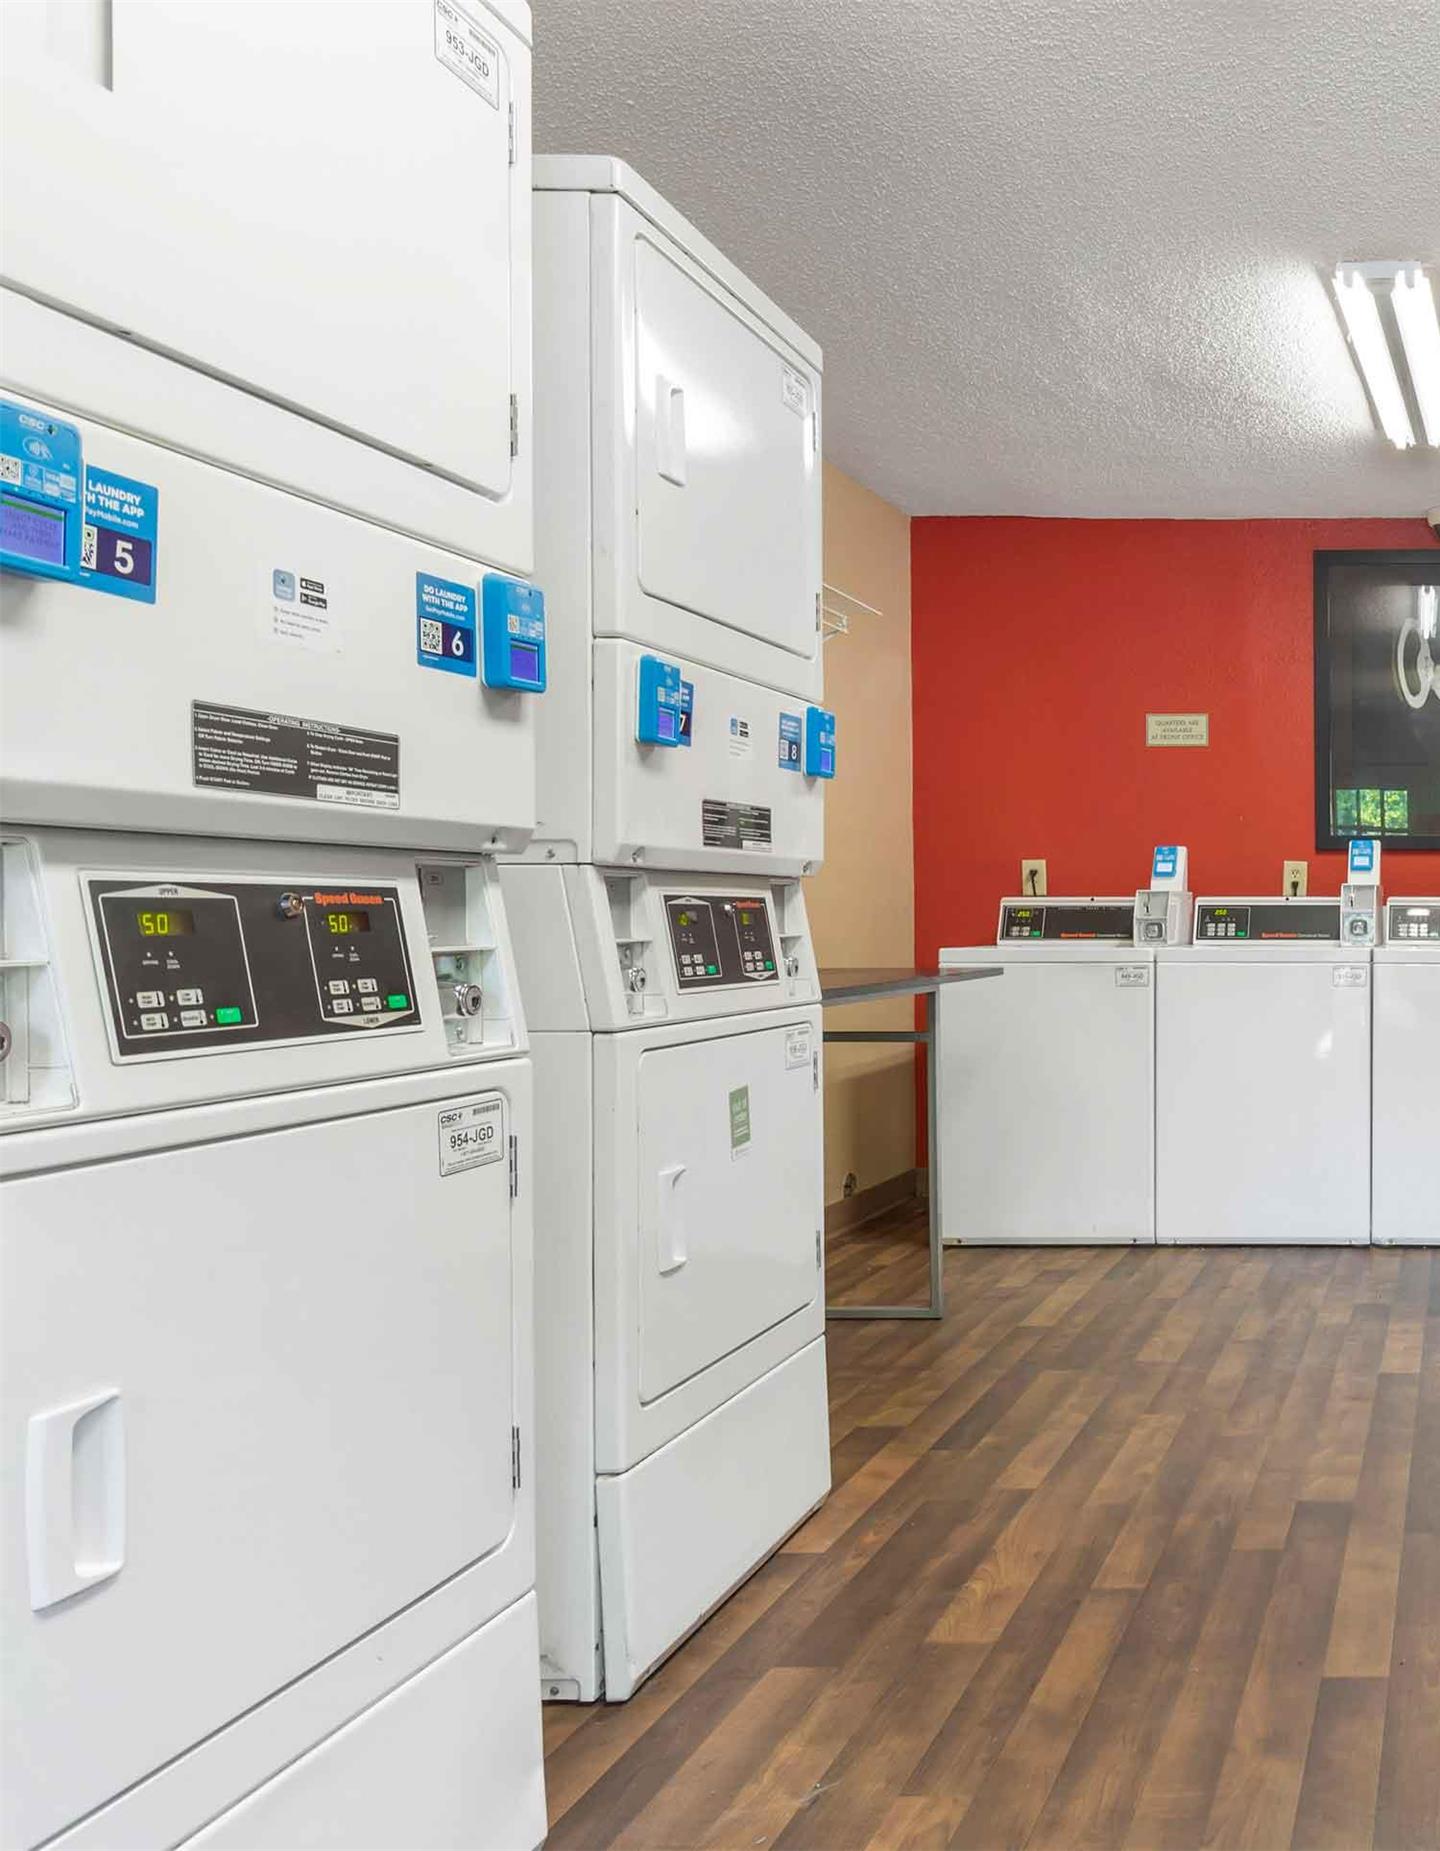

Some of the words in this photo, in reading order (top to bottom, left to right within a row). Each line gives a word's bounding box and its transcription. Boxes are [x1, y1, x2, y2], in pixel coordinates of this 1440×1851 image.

[445, 30, 490, 77] 953-JGD
[88, 479, 141, 506] LAUNDRY
[98, 494, 120, 511] THE
[122, 502, 145, 518] APP
[114, 539, 134, 574] 5
[422, 592, 440, 606] WITH
[441, 598, 454, 609] THE
[455, 603, 468, 613] APP
[435, 588, 466, 603] LAUNDRY
[452, 630, 465, 656] 6
[680, 713, 687, 732] 7
[791, 744, 798, 760] 8
[159, 887, 179, 896] UPPER
[313, 891, 349, 907] Speed
[349, 892, 384, 905] Queen
[142, 912, 169, 935] 50
[328, 914, 349, 933] 50
[363, 1016, 379, 1024] LOWER
[440, 1113, 457, 1124] CSC
[450, 1126, 494, 1149] 954-JGD
